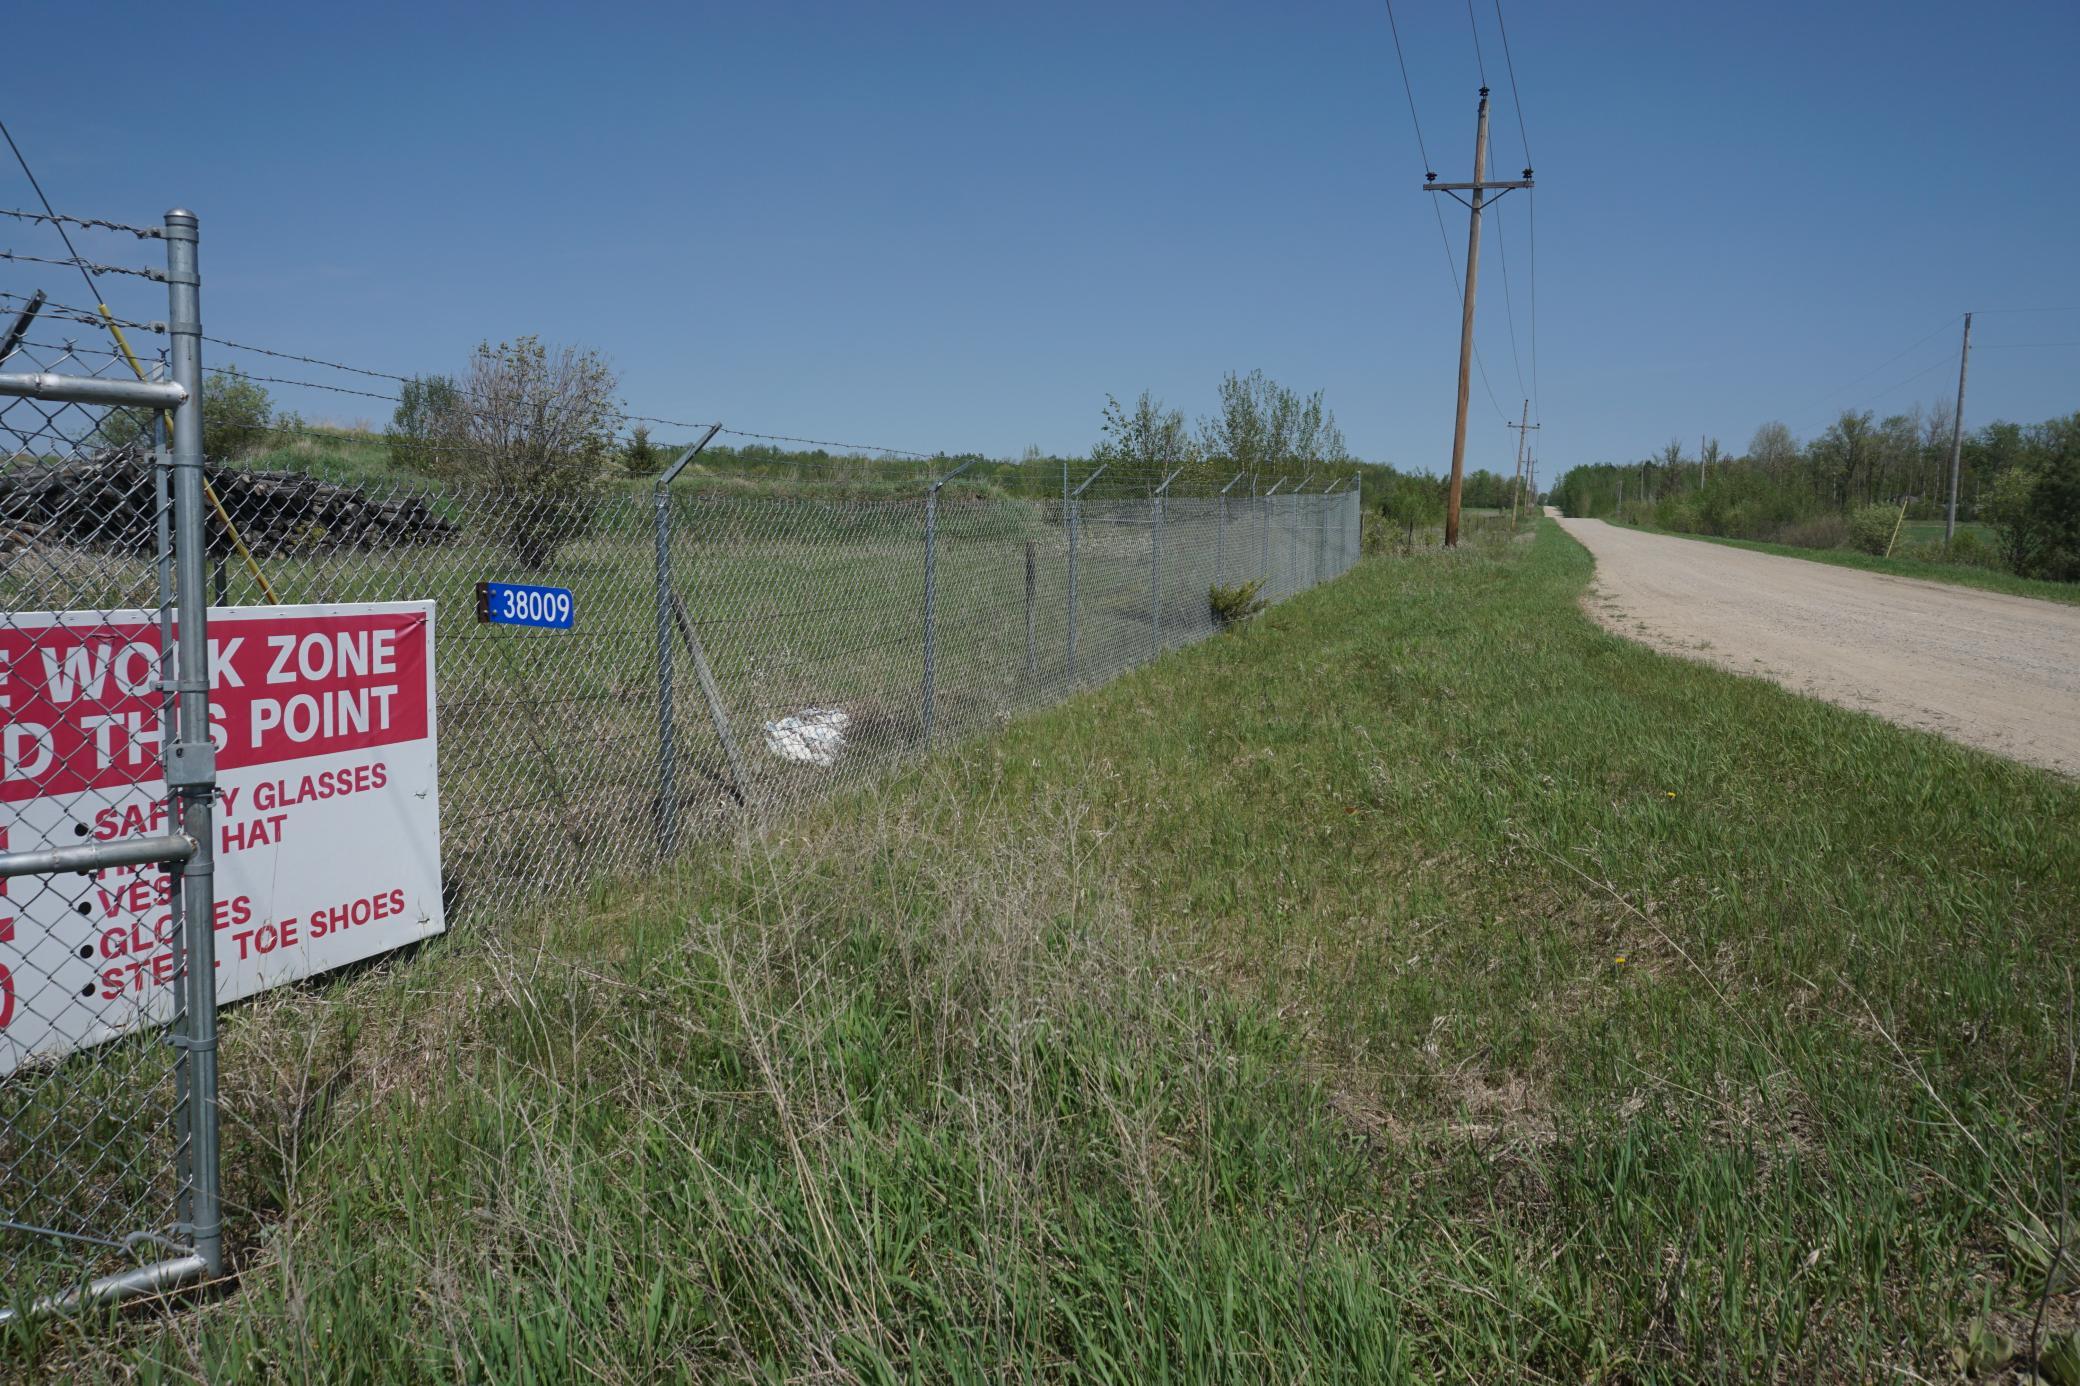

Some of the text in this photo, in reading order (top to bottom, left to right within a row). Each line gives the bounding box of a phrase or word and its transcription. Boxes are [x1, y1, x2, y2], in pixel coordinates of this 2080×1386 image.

[503, 590, 570, 623] 38009
[40, 637, 246, 703] WOK
[266, 629, 398, 685] ZONE
[250, 685, 399, 749] POINT
[94, 762, 388, 841] SAFY GLASSES
[221, 814, 288, 854] HAT
[97, 875, 172, 918] VES
[100, 895, 252, 960] GLOES
[232, 918, 299, 961] TOE
[310, 888, 405, 938] SHOES
